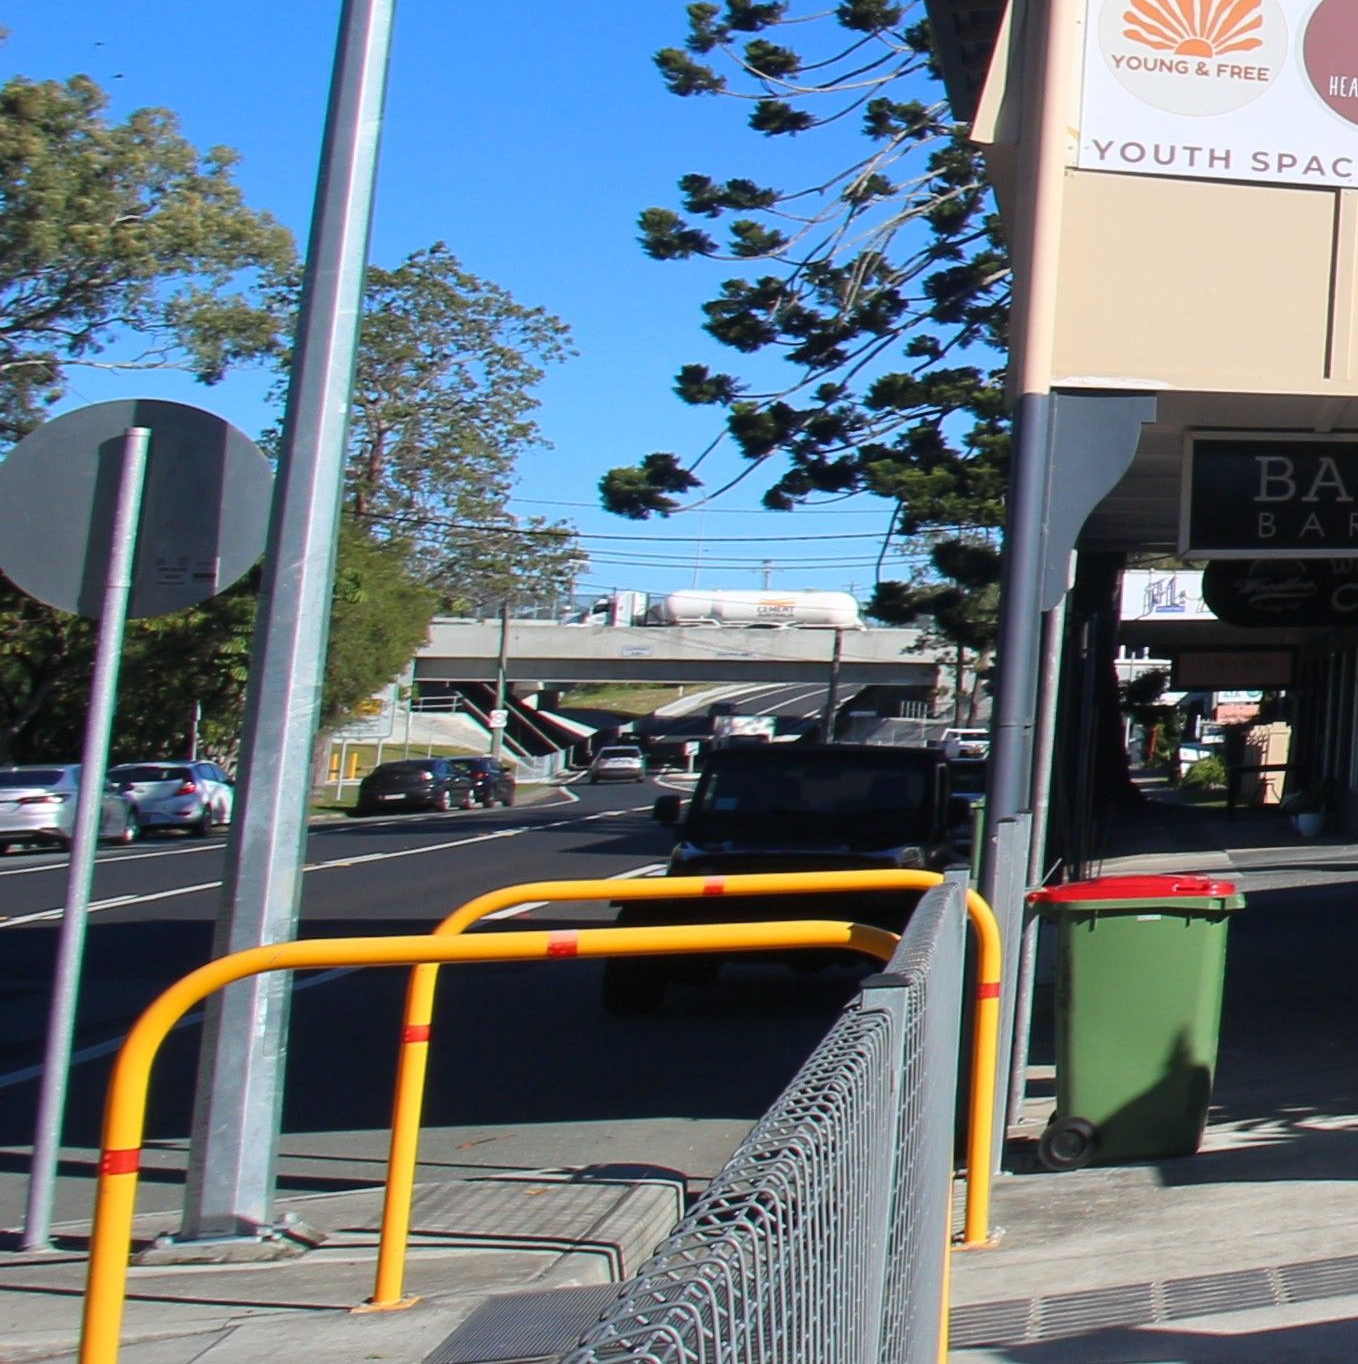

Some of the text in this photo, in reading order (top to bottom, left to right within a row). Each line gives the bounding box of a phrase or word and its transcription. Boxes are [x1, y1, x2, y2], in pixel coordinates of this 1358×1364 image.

[1111, 54, 1270, 82] YOUNG & FREE
[1092, 139, 1232, 170] YOUTH
